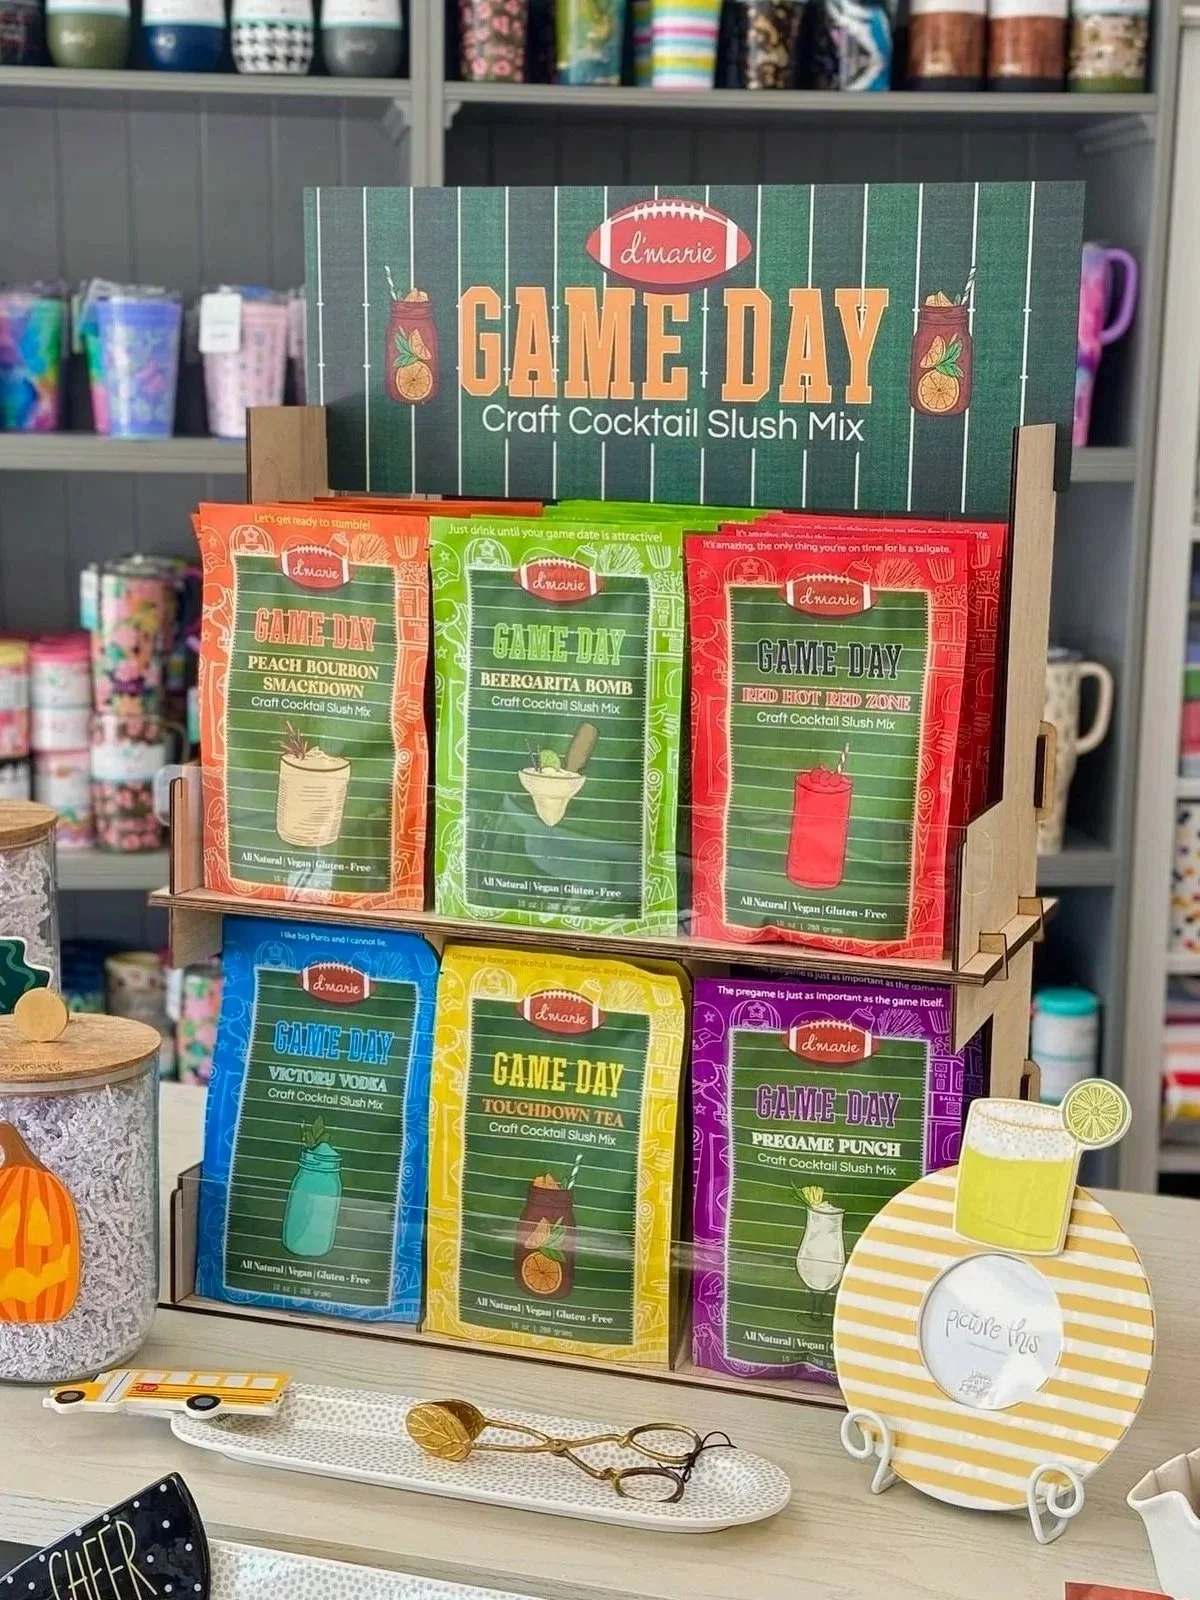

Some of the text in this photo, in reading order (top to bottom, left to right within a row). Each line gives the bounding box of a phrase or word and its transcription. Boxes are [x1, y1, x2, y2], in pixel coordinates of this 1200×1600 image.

[620, 230, 718, 265] d'marie
[460, 286, 889, 404] GAME DAY
[482, 403, 865, 442] Craft Cocktail Slush Mix
[254, 513, 371, 531] Let's get ready to stumble!
[449, 523, 662, 543] Just drink until your game date is attractive!
[703, 540, 716, 549] It's
[716, 541, 756, 552] amazing,
[757, 541, 773, 550] the
[773, 541, 794, 552] only
[795, 541, 818, 553] thing
[820, 543, 846, 553] you're
[861, 543, 883, 553] time
[884, 543, 898, 553] for
[899, 544, 907, 553] is
[915, 543, 951, 555] tailgate.
[292, 559, 340, 581] d'marie
[532, 571, 587, 592] d'marie
[800, 586, 859, 607] d'marie
[254, 607, 376, 652] GAME DAY
[492, 622, 626, 666] GAME DAY
[248, 655, 379, 680] PEACH BOURBON
[757, 638, 902, 680] GAME DAY
[263, 676, 365, 699] SMACKDOWN
[481, 671, 633, 696] BEERGARITA BOMB
[251, 696, 371, 717] Craft Cocktail Slush Mix
[491, 695, 620, 715] Craft Cocktail Slush Mix
[742, 686, 911, 712] RED HOT RED ZONE
[757, 711, 897, 731] Craft Cocktail Slush Mix
[241, 851, 252, 861] All
[252, 853, 283, 865] Natural
[286, 856, 312, 869] Vegan
[481, 876, 495, 886] All
[495, 877, 528, 890] Natural
[532, 881, 559, 893] Vegan
[740, 896, 752, 906] All
[753, 897, 787, 911] Natural
[792, 901, 821, 914] Vegan
[284, 931, 297, 939] like
[298, 932, 310, 942] big
[331, 935, 345, 944] and
[350, 937, 376, 946] cannot
[313, 976, 361, 994] d'marie
[814, 970, 830, 980] just
[842, 974, 884, 986] important
[885, 980, 895, 988] as
[895, 981, 910, 990] the
[717, 985, 944, 1008] The pregame is just as important as the game itself.
[534, 1003, 588, 1026] d'marie
[273, 1020, 394, 1066] GAME DAY
[801, 1033, 860, 1054] d'marie
[268, 1065, 387, 1093] VICTORY VODKA
[492, 1051, 624, 1098] GAME DAY
[268, 1087, 384, 1111] Craft Cocktail Slush Mix
[755, 1084, 900, 1128] GAME DAY
[482, 1097, 625, 1128] TOUCHDOWN TEA
[488, 1121, 617, 1146] Craft Cocktail Slush Mix
[751, 1131, 901, 1158] PREGAME PUNCH
[757, 1152, 897, 1176] Craft Cocktail Slush Mix
[240, 1259, 253, 1269] All
[253, 1261, 284, 1275] Natural
[288, 1266, 313, 1278] Vegan
[476, 1296, 488, 1306] All
[488, 1298, 521, 1312] Natural
[525, 1304, 552, 1317] Vegan
[743, 1330, 825, 1350] All Natural Vegan
[945, 1309, 1041, 1354] picture this
[48, 1520, 158, 1600] CHEER
